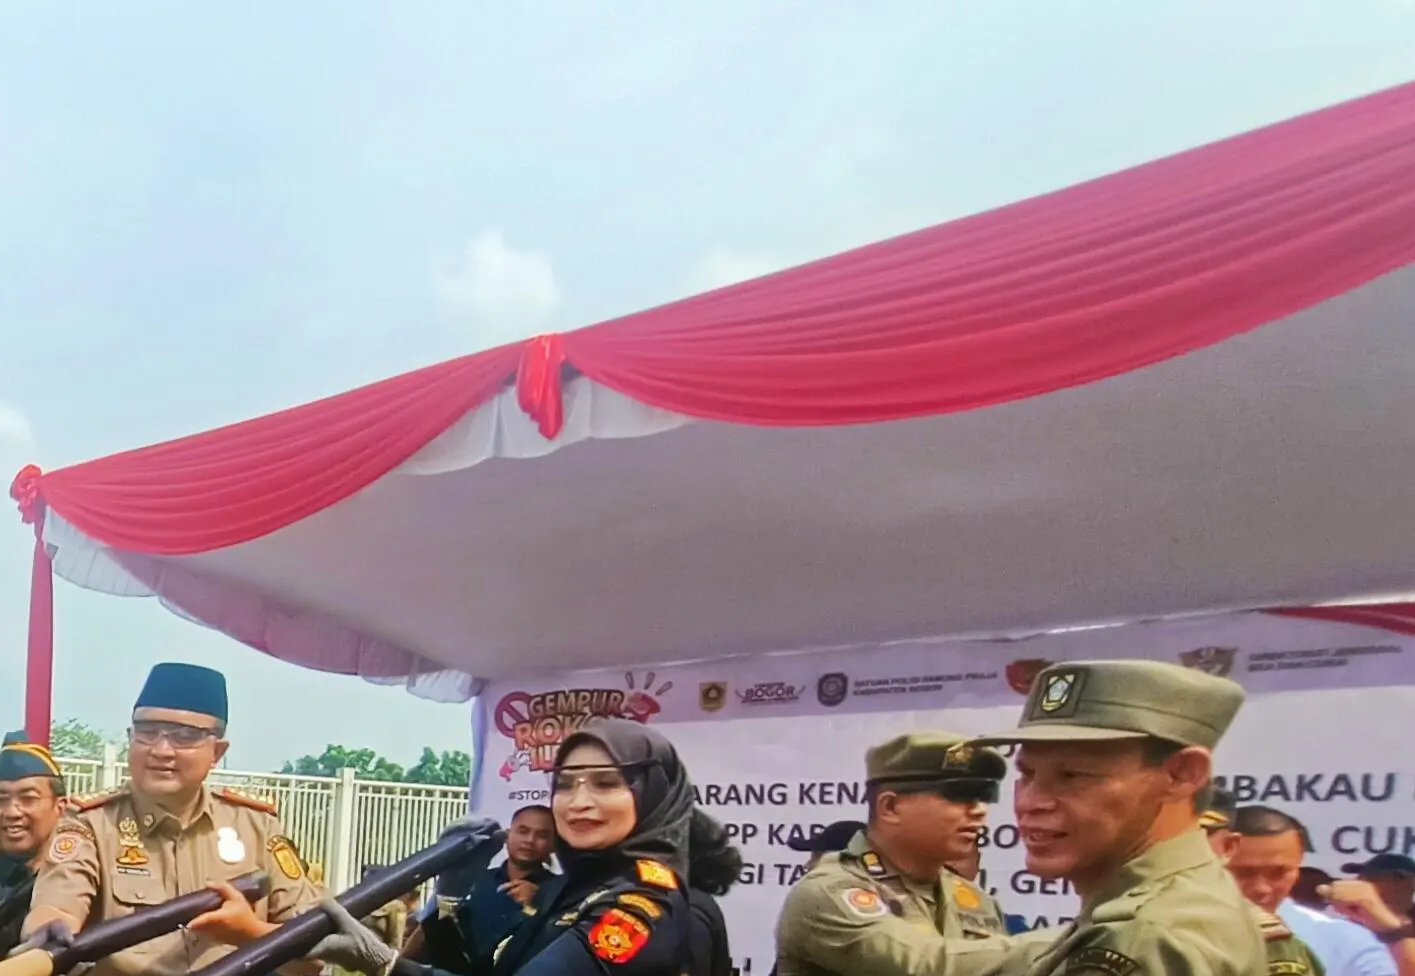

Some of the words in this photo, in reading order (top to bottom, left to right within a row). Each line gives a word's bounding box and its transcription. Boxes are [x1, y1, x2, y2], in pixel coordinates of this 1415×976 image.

[528, 690, 625, 717] GEMPUR
[508, 790, 550, 801] #STOP
[692, 783, 789, 806] ARANG
